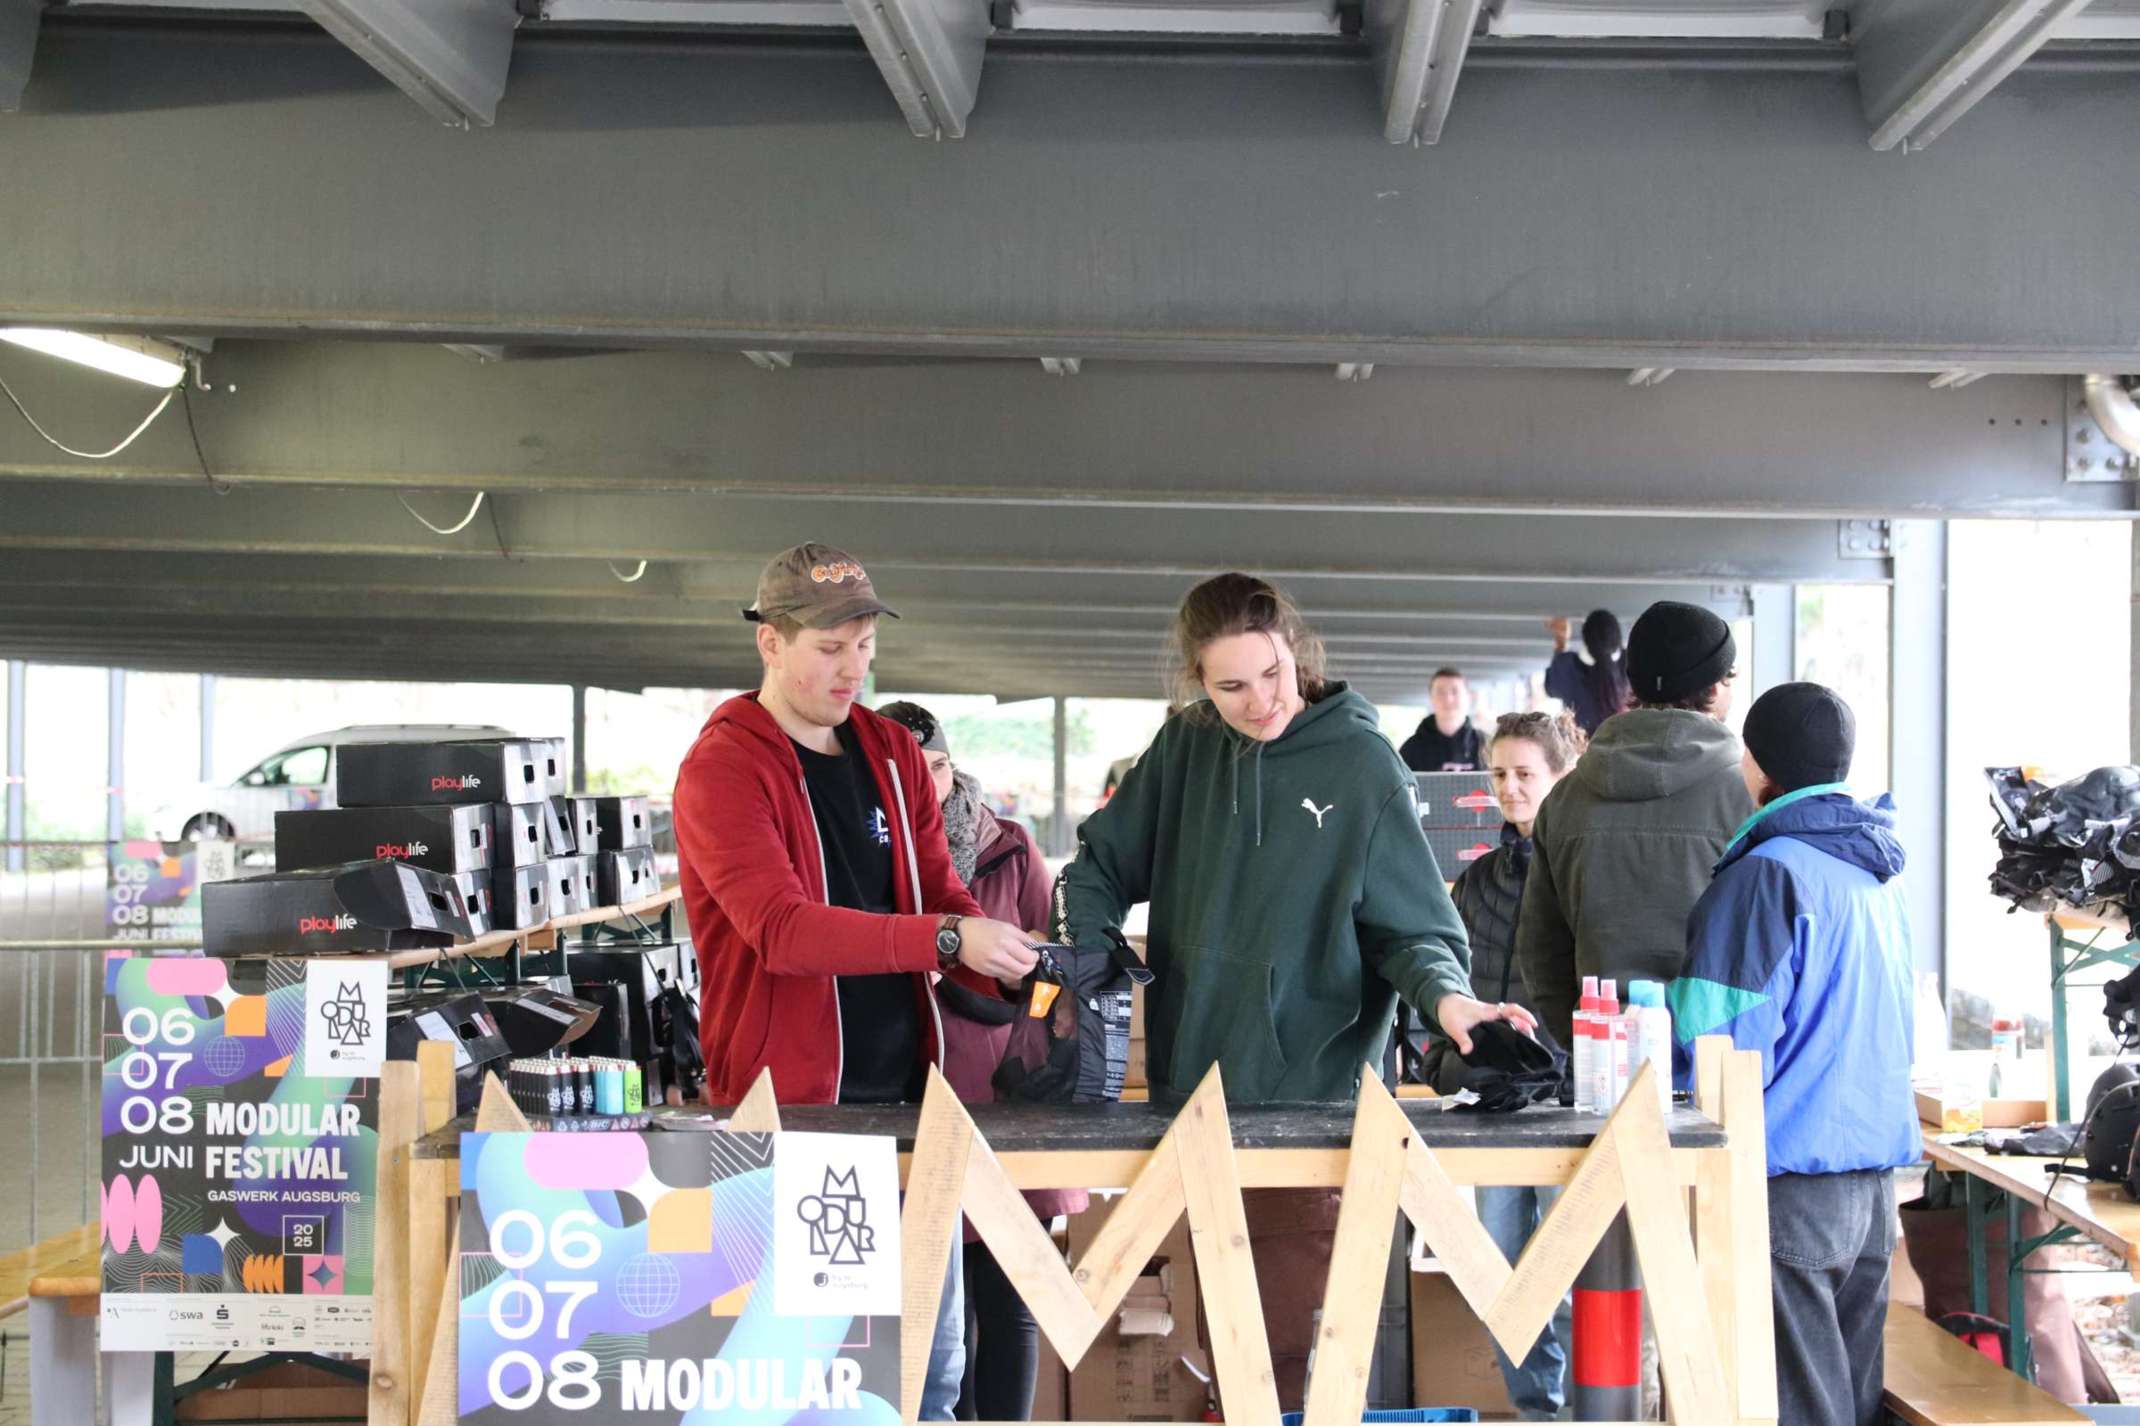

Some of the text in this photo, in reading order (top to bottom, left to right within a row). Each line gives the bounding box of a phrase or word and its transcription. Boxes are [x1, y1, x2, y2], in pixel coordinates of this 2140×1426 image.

[431, 774, 481, 791] playlife
[376, 841, 429, 859] playlife
[114, 864, 149, 884] 06
[113, 884, 148, 904] 07
[112, 905, 149, 925] 08
[299, 913, 357, 935] playlife
[122, 1007, 195, 1046] 06
[120, 1051, 193, 1090] 07
[120, 1096, 360, 1137] 08 MODULAR
[119, 1145, 348, 1180] JUNI FESTIVAL
[207, 1190, 361, 1203] GASWERK AUGSBURG
[293, 1223, 314, 1235] 20
[293, 1236, 313, 1247] 25
[489, 1209, 602, 1270] 06
[179, 1311, 204, 1320] swa
[488, 1280, 599, 1340] 07
[487, 1350, 863, 1411] 08 MODULAR
